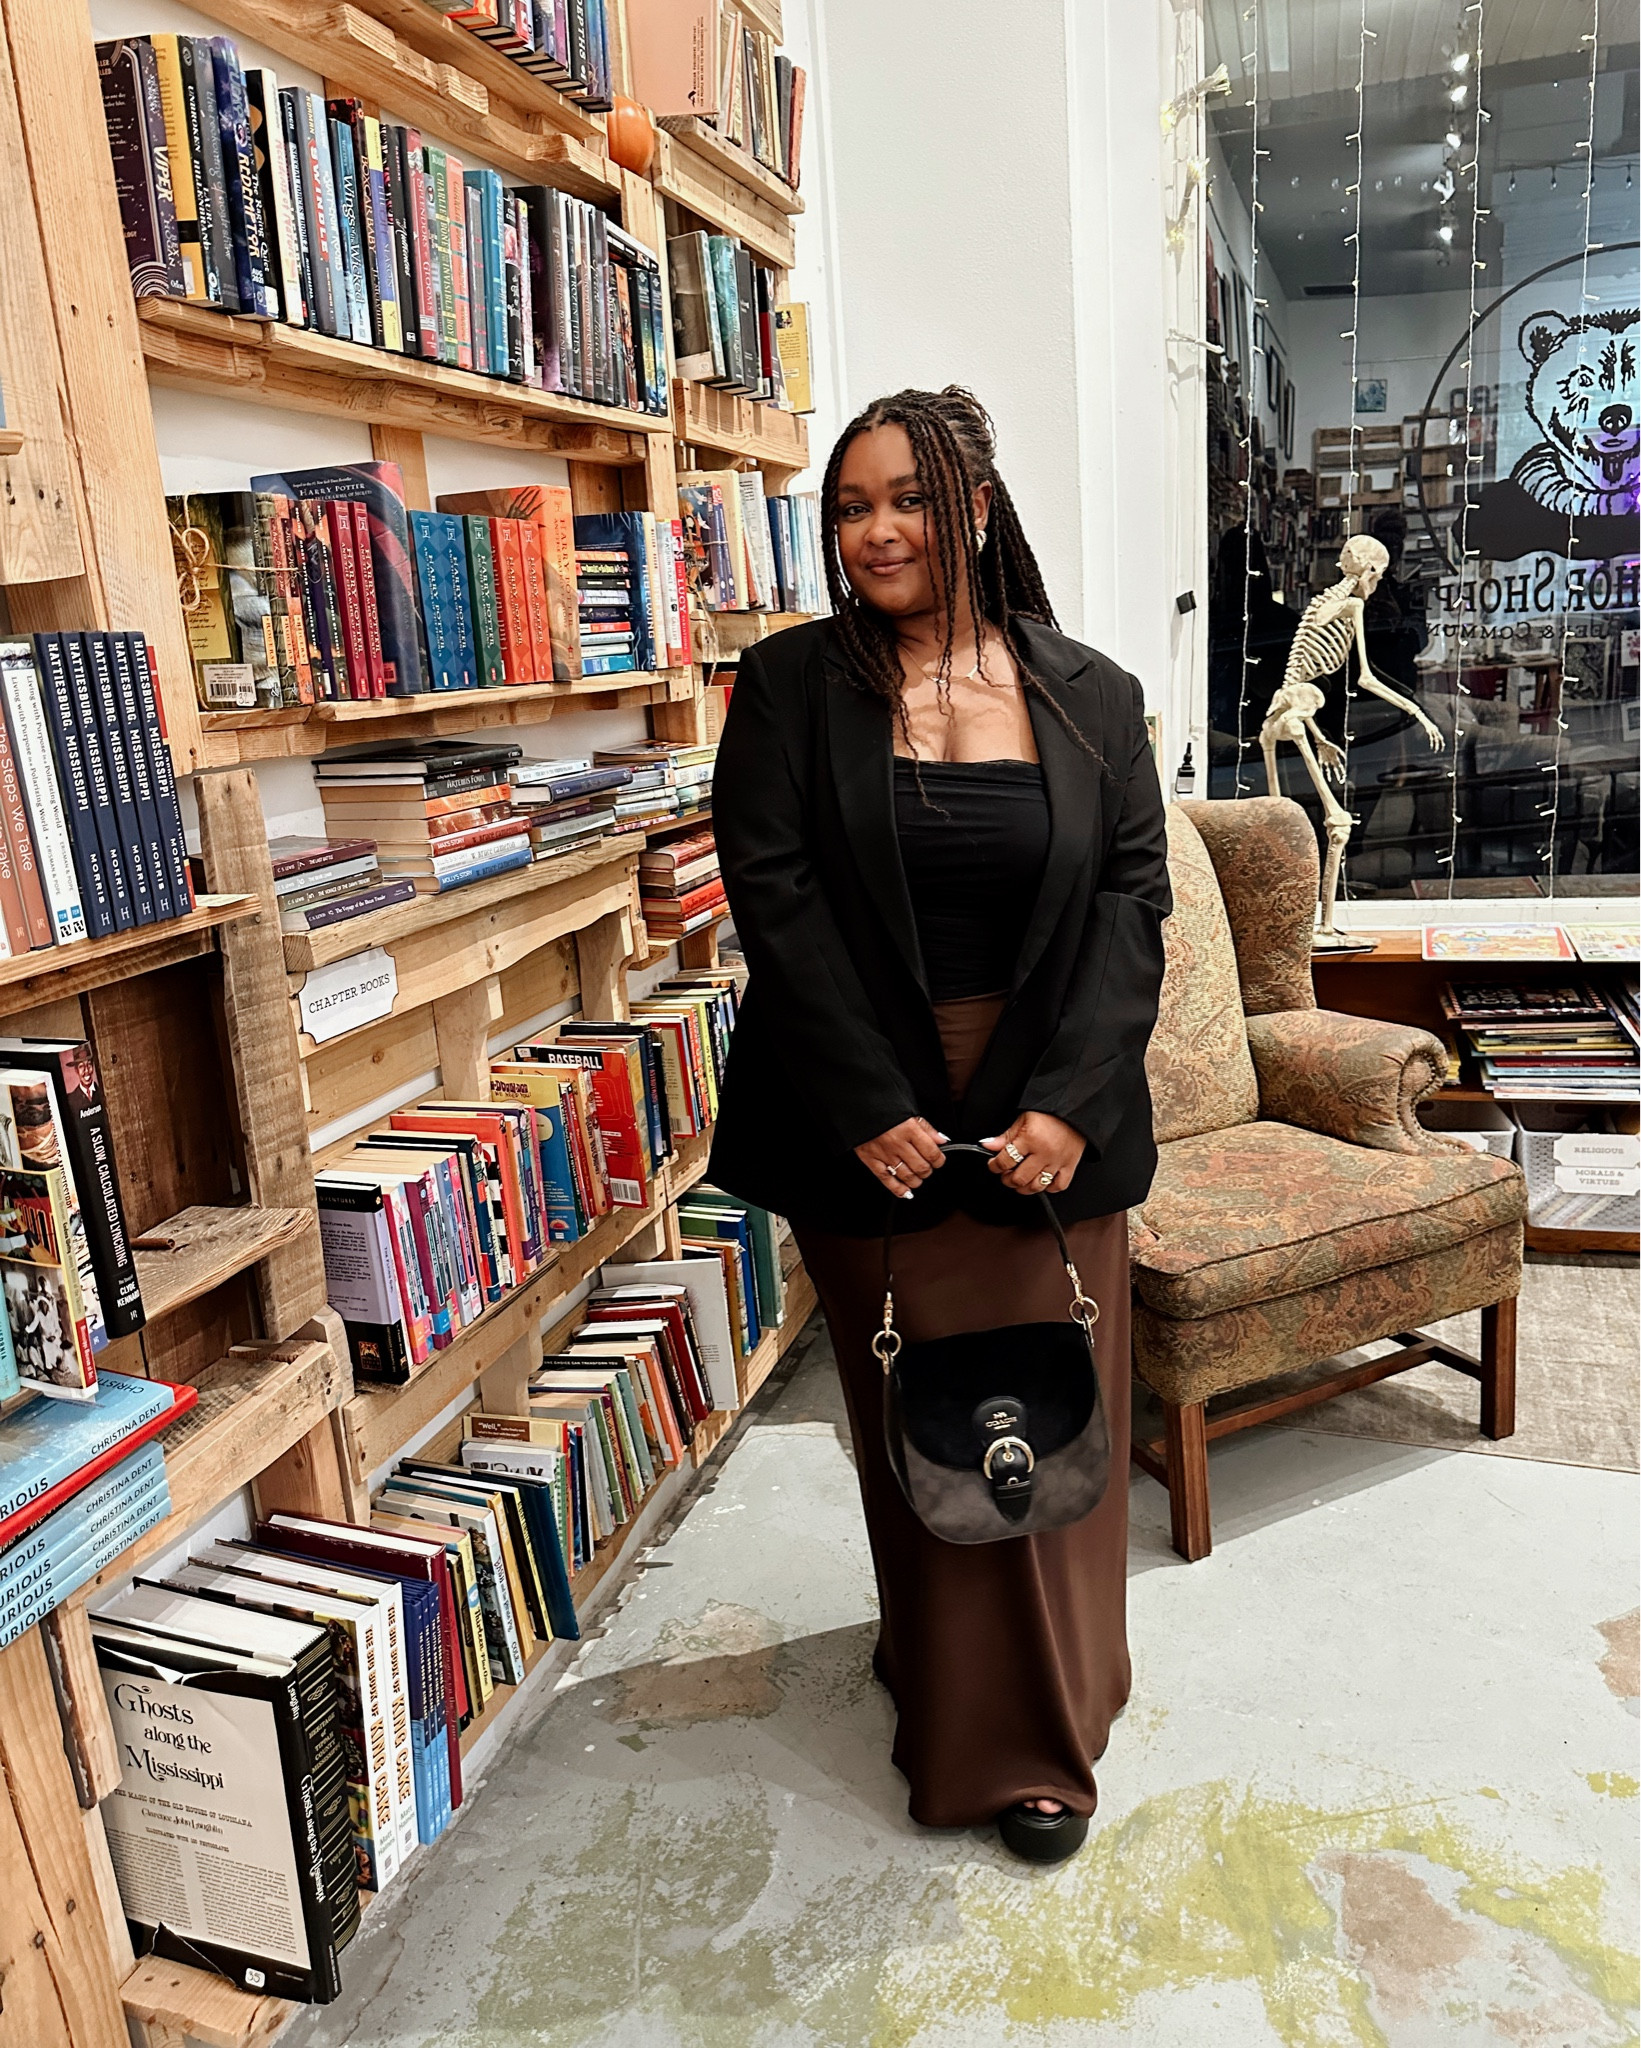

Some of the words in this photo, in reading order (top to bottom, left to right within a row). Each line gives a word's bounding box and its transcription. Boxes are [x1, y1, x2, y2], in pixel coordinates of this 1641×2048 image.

[575, 0, 586, 60] DEPTHS
[184, 84, 202, 153] UNBROKEN
[203, 90, 216, 113] the
[284, 101, 297, 130] LYNCH
[305, 94, 315, 135] KORMAN
[202, 114, 221, 179] reckoning
[152, 145, 173, 203] VIPER
[209, 180, 226, 194] of
[249, 171, 260, 197] The
[360, 154, 373, 214] BOXCAR
[436, 171, 445, 214] CHARLIE
[191, 157, 212, 251] HILLENBRAND
[202, 185, 214, 229] LAURA
[238, 150, 260, 259] REDEMPTOR
[253, 198, 265, 239] Raging
[310, 144, 328, 253] SWINDLE
[415, 178, 430, 247] SPLENDORS
[163, 218, 176, 267] HOGAN
[340, 173, 357, 225] Wings
[349, 242, 364, 303] Wicked
[365, 214, 376, 253] BABY
[439, 220, 448, 245] BONE
[258, 240, 271, 272] Quiet
[422, 260, 435, 311] GLOOMS
[442, 262, 452, 310] INVISIBLE
[569, 273, 578, 316] FROZEN
[444, 317, 455, 335] BOY
[570, 317, 580, 355] TIDES
[300, 485, 332, 497] HARRY
[335, 482, 366, 493] POTTER
[558, 518, 570, 572] HARRY
[508, 555, 519, 599] HARRY
[529, 555, 539, 597] HARRY
[676, 577, 686, 613] LUCY
[345, 547, 357, 598] HARRY
[352, 601, 363, 653] POTTER
[364, 547, 374, 598] HARRY
[369, 601, 380, 653] POTTER
[428, 553, 438, 600] HARRY
[435, 603, 445, 649] POTTER
[452, 555, 461, 601] HARRY
[458, 604, 466, 648] POTTER
[479, 554, 491, 599] HARRY
[485, 602, 495, 646] POTTER
[563, 576, 575, 628] POTTER
[641, 562, 654, 639] REBELWING
[512, 601, 522, 645] POTTER
[533, 600, 543, 644] POTTER
[8, 674, 21, 700] Living
[23, 674, 36, 699] Living
[16, 702, 25, 721] with
[31, 701, 40, 720] with
[48, 641, 71, 731] HATTIESBURG,
[66, 733, 87, 811] MISSISSIPPI
[70, 640, 92, 728] HATTIESBURG,
[86, 732, 107, 807] MISSISSIPPI
[94, 639, 116, 727] HATTIESBURG,
[110, 728, 130, 804] MISSISSIPPI
[115, 639, 137, 725] HATTIESBURG,
[129, 728, 149, 802] MISSISSIPPI
[134, 639, 157, 723] HATTIESBURG,
[148, 726, 168, 798] MISSISSIPPI
[0, 721, 10, 756] The
[19, 722, 32, 756] Purpose
[33, 722, 46, 754] Purpose
[1, 758, 18, 803] Steps
[27, 766, 42, 807] Polarizing
[42, 764, 56, 804] Polarizing
[445, 775, 471, 789] ARTEMIS
[470, 773, 486, 783] FOWL
[12, 806, 25, 833] We
[38, 808, 48, 832] World
[52, 805, 62, 828] World
[0, 843, 11, 880] Take
[18, 836, 33, 872] Take
[109, 848, 123, 899] MORRIS
[131, 844, 146, 894] MORRIS
[150, 841, 164, 890] MORRIS
[170, 837, 183, 885] MORRIS
[457, 868, 474, 879] STORY
[90, 853, 104, 904] MORRIS
[308, 984, 359, 1014] CHAPTER
[360, 973, 390, 997] BOOKS
[548, 1053, 603, 1070] BASEBALL
[77, 1103, 103, 1118] Anderson
[88, 1126, 101, 1135] A
[87, 1134, 108, 1165] SLOW,
[96, 1163, 119, 1222] CALCULATED
[1575, 1169, 1615, 1177] MORALS
[1579, 1178, 1620, 1186] VIRTUES
[108, 1221, 129, 1267] LYNCHING
[118, 1280, 137, 1296] CLYDE
[90, 1419, 137, 1455] CHRISTINA
[137, 1402, 162, 1422] DENT
[985, 1416, 1018, 1428] COACH
[85, 1476, 129, 1513] CHRISTINA
[129, 1457, 153, 1478] DENT
[89, 1494, 133, 1533] CHRISTINA
[132, 1476, 155, 1497] DENT
[90, 1513, 134, 1552] CHRISTINA
[134, 1494, 158, 1515] DENT
[94, 1530, 137, 1568] CHRISTINA
[137, 1510, 161, 1533] DENT
[386, 1602, 397, 1626] THE
[473, 1608, 487, 1651] Thirteen
[363, 1624, 375, 1649] THE
[388, 1626, 398, 1648] BIG
[510, 1640, 520, 1662] COLE
[365, 1648, 376, 1671] BIG
[389, 1647, 401, 1678] BOOK
[479, 1651, 488, 1670] Plus
[482, 1669, 490, 1686] One
[114, 1683, 194, 1725] Ghosts
[367, 1670, 379, 1701] BOOK
[392, 1677, 401, 1694] OF
[308, 1712, 336, 1739] HERITAGE
[370, 1701, 379, 1718] OF
[391, 1692, 408, 1748] KING
[144, 1725, 186, 1750] along
[187, 1734, 212, 1755] the
[314, 1739, 337, 1762] COUNTY
[369, 1715, 388, 1773] KING
[124, 1743, 224, 1791] Mississippi
[395, 1747, 411, 1804] CAKE
[128, 1791, 148, 1802] MAGIC
[149, 1796, 156, 1804] OF
[157, 1798, 171, 1808] THE
[172, 1802, 184, 1811] OLD
[209, 1810, 217, 1819] OF
[218, 1813, 253, 1827] LOUISIANA
[300, 1773, 314, 1817] Ghosts
[373, 1770, 391, 1830] CAKE
[307, 1816, 317, 1840] along
[310, 1839, 319, 1853] the
[310, 1849, 326, 1902] Mississippi
[246, 1970, 262, 1984] 35
